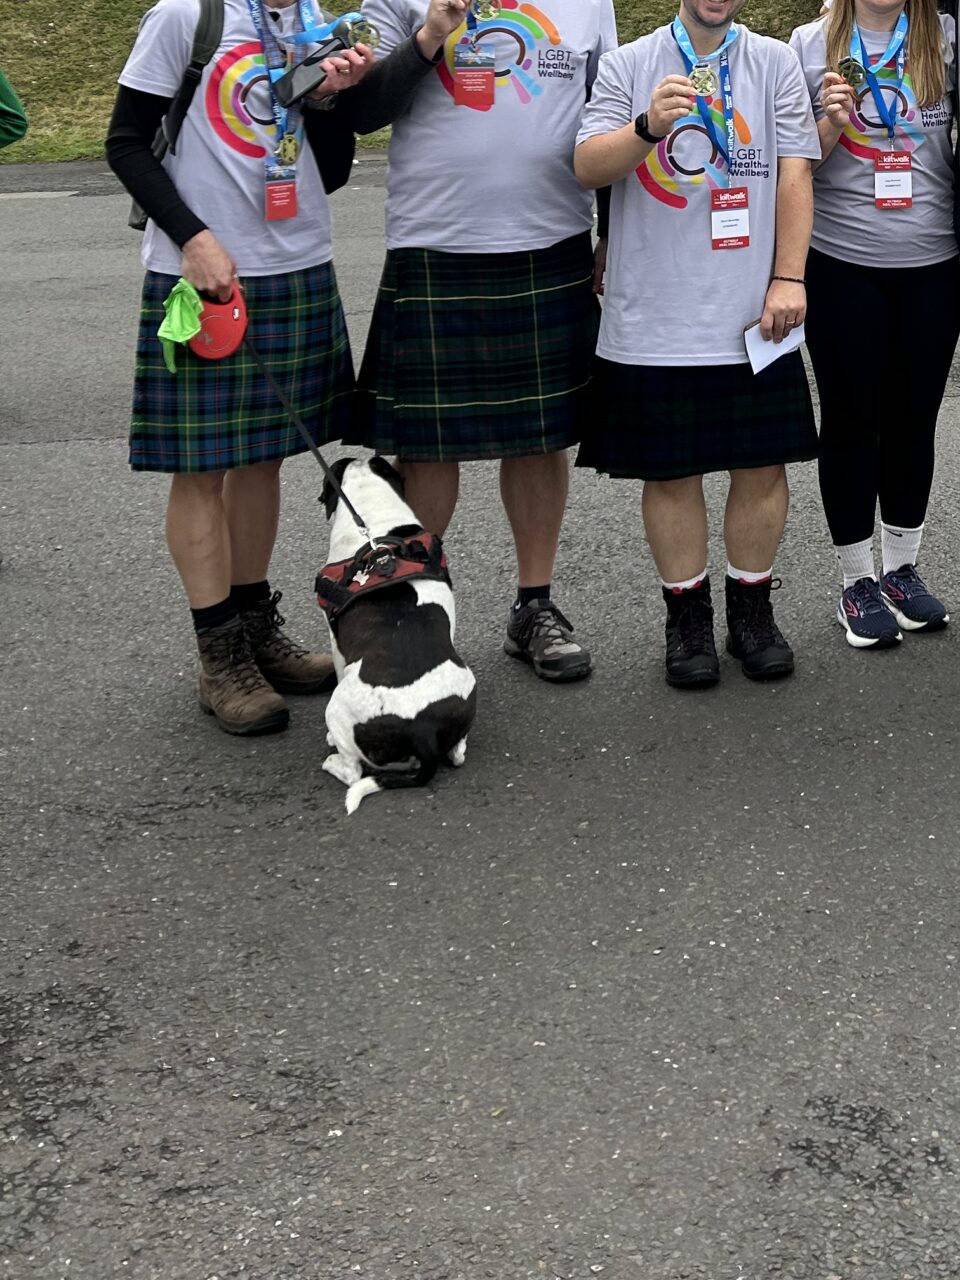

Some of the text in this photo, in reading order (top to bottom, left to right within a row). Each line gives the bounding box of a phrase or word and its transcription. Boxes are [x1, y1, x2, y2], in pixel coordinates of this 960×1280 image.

[538, 49, 572, 61] LGBT
[538, 61, 570, 70] Health
[726, 118, 735, 150] kiltwalk
[731, 148, 763, 160] GBT
[730, 160, 762, 169] Health
